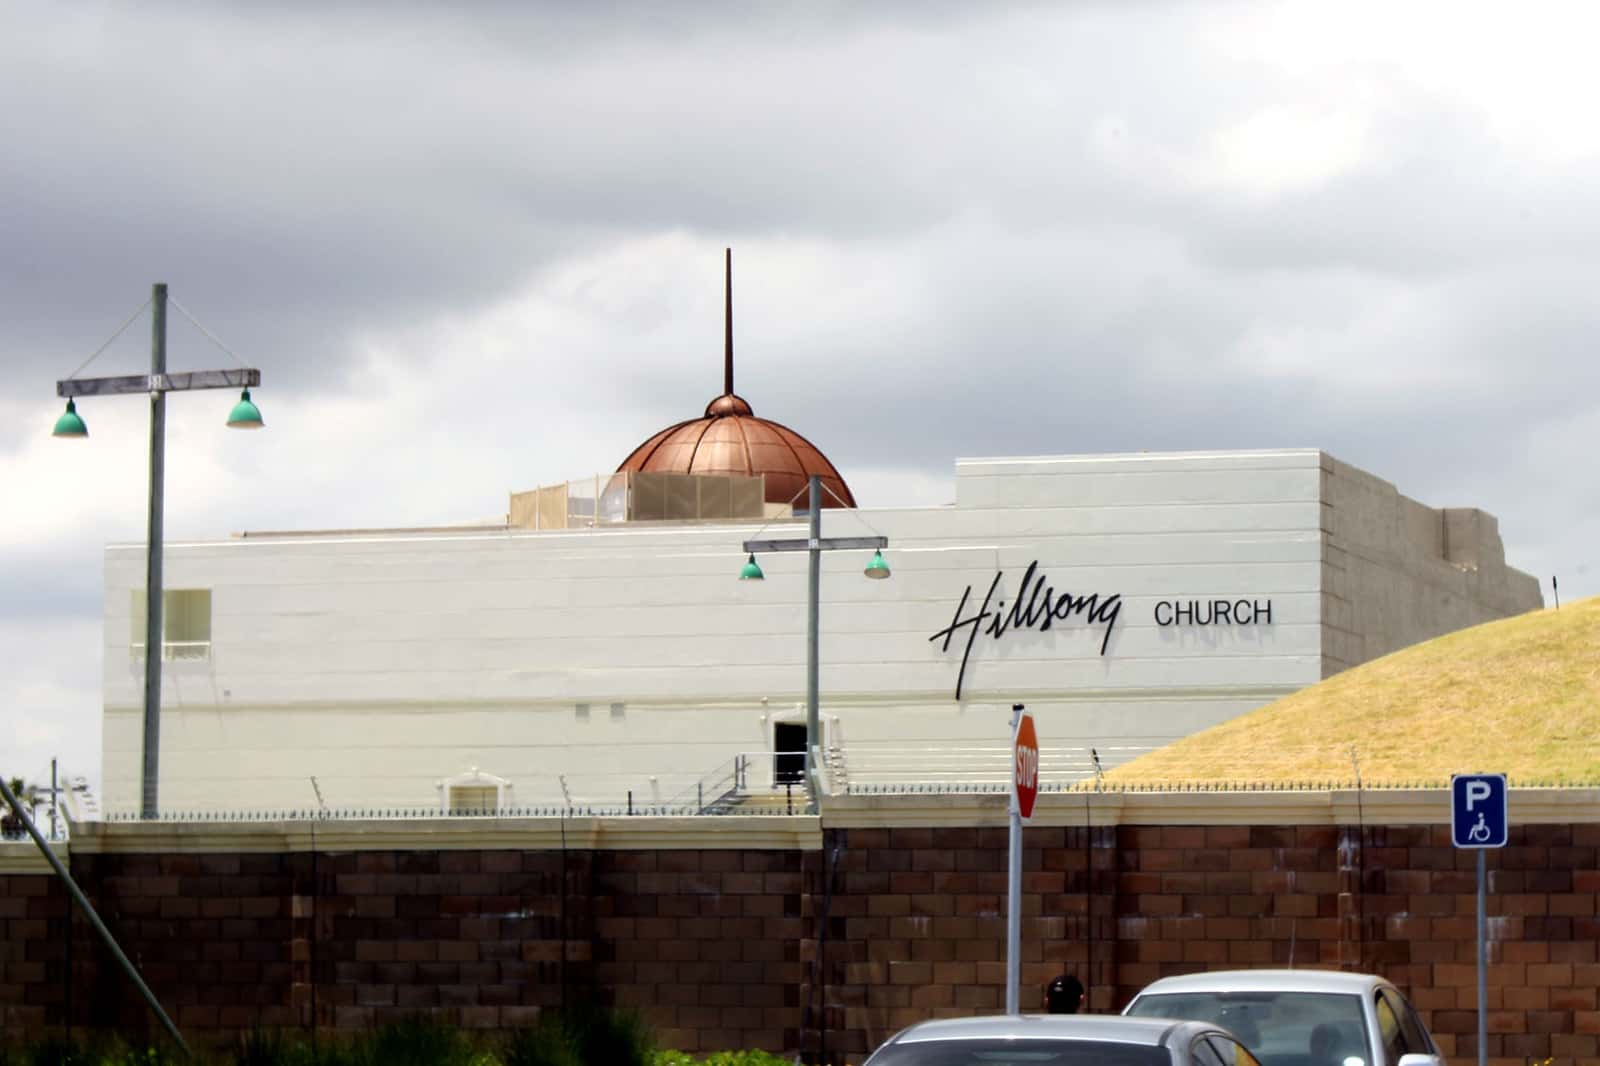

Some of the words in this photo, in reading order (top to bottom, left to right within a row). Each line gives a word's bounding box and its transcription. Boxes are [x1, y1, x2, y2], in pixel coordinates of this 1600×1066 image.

[929, 560, 1121, 700] Hillsong
[1154, 599, 1272, 625] CHURCH
[1017, 745, 1037, 789] STOP
[1466, 781, 1491, 811] P
